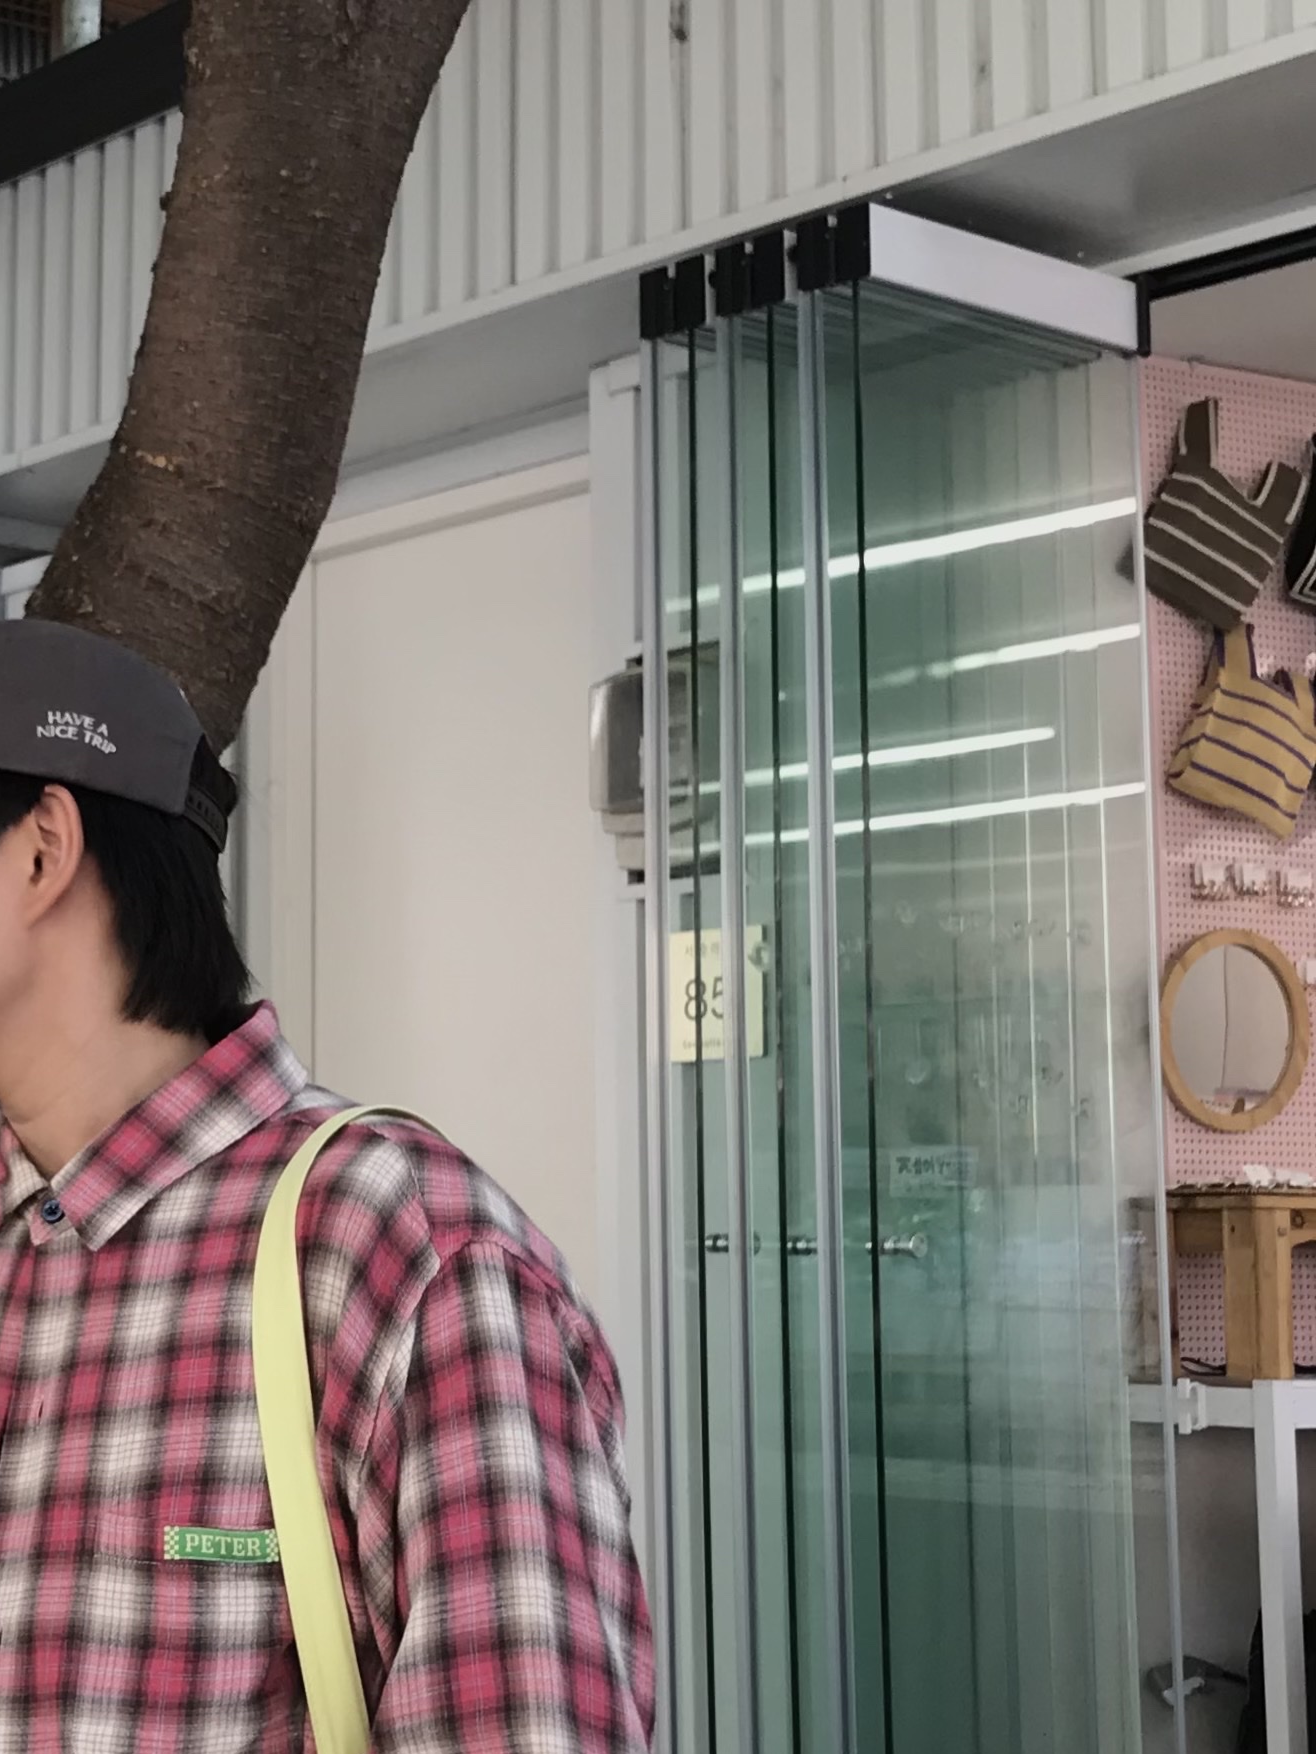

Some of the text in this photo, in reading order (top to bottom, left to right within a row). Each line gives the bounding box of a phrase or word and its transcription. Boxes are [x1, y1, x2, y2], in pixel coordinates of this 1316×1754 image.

[47, 710, 108, 737] HAVE A
[36, 725, 117, 754] NICE TRIP
[185, 1533, 262, 1557] PETER
